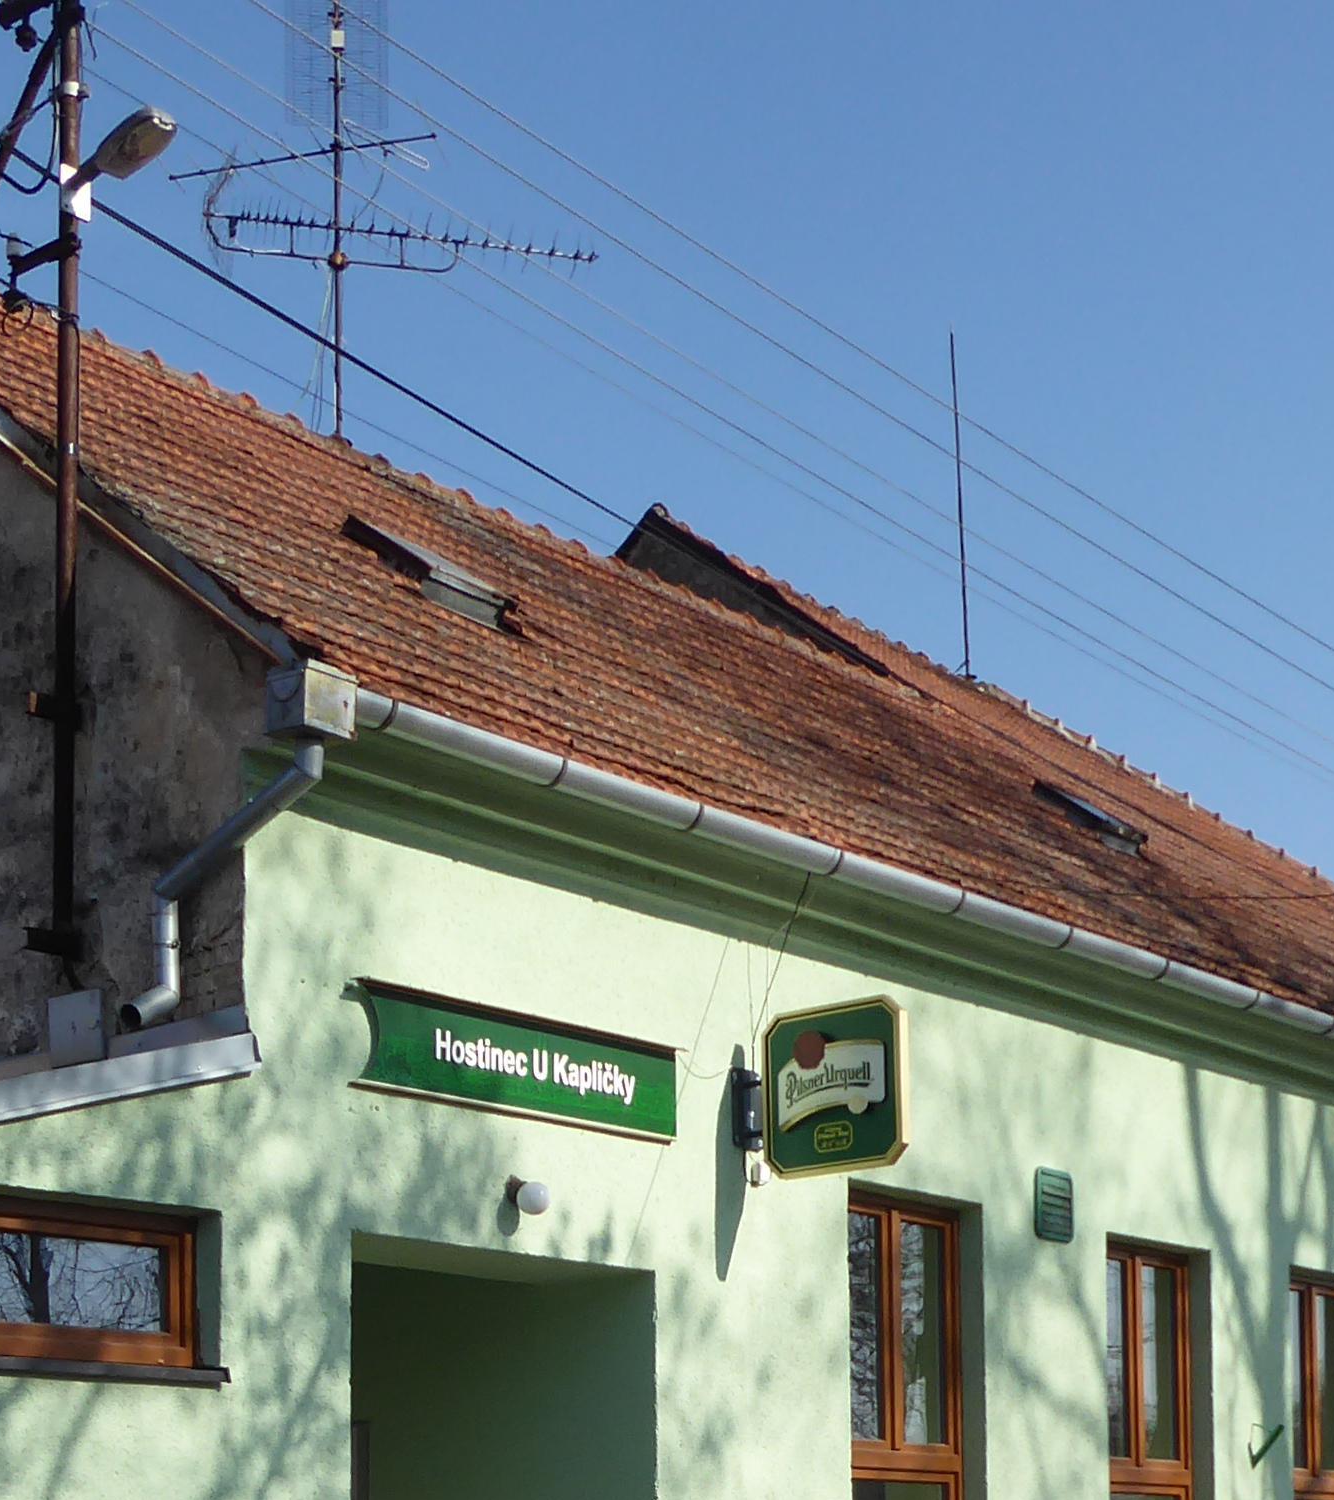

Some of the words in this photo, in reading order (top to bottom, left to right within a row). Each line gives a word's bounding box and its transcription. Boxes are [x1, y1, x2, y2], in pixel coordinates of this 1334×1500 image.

[434, 1028, 528, 1078] Hostinec
[532, 1049, 549, 1083] U
[553, 1053, 637, 1106] Kapličky
[785, 1071, 824, 1109] Pilsner
[824, 1061, 871, 1090] Urquell
